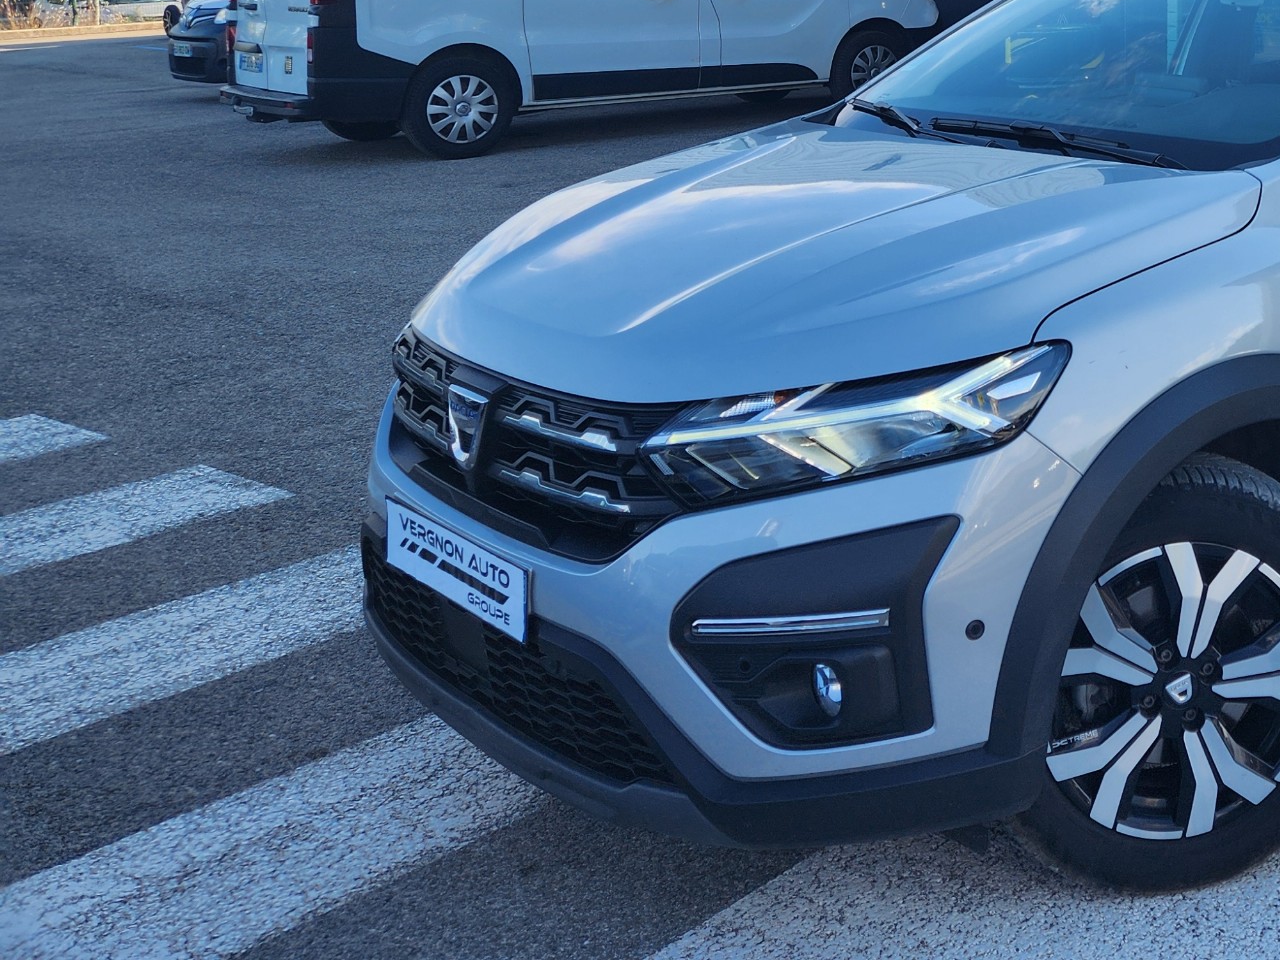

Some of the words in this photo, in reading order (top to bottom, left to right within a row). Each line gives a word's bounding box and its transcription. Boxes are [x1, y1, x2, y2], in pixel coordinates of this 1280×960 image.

[399, 512, 464, 564] VERGNON
[467, 553, 511, 589] AUTO
[467, 592, 511, 626] GROUPE
